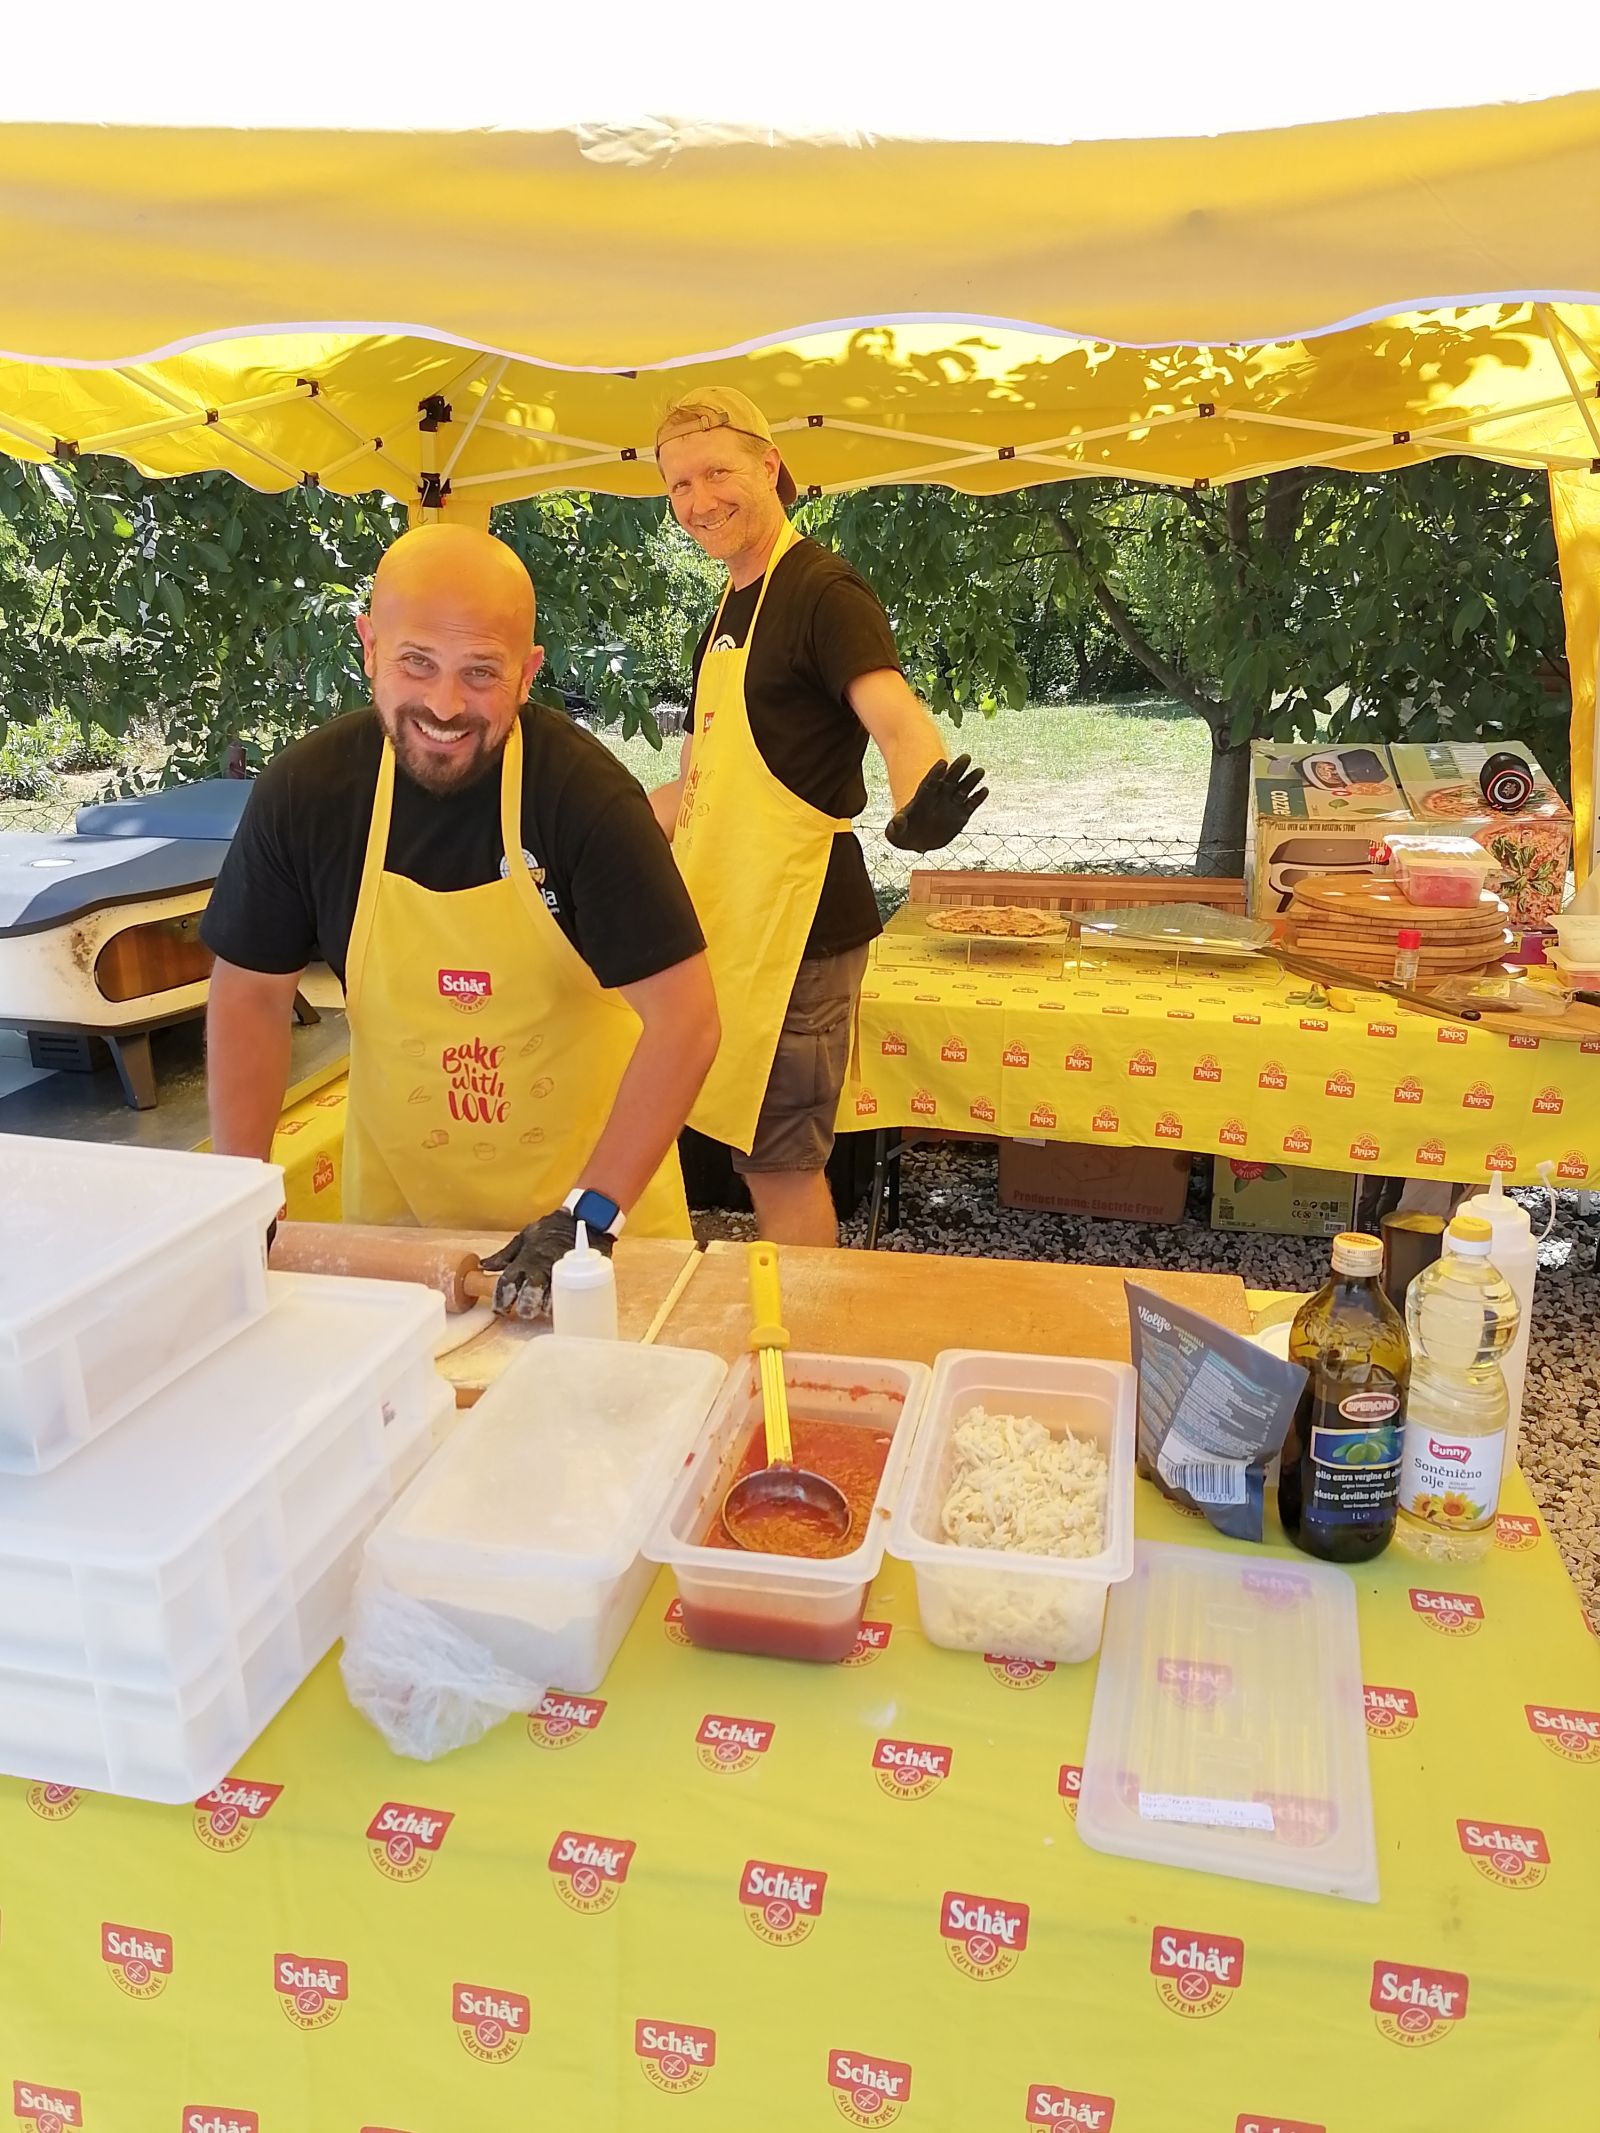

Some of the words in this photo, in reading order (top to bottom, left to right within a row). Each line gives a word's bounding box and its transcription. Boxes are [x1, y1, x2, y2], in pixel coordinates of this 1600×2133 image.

[1309, 824, 1320, 832] WITH
[1343, 824, 1356, 832] STONE
[442, 974, 487, 996] Schär
[442, 1037, 506, 1074] Bake
[452, 1063, 504, 1098] with
[1014, 1190, 1056, 1204] Product
[1091, 1200, 1133, 1213] Electric
[1135, 1203, 1164, 1216] Fryer
[1137, 1305, 1172, 1333] Violife
[1345, 1400, 1394, 1412] SPERONI
[1432, 1443, 1467, 1459] Sunny
[1315, 1470, 1331, 1480] olio
[1355, 1472, 1382, 1482] vergine
[1383, 1470, 1391, 1479] di
[1414, 1457, 1482, 1479] Sončnično
[1421, 1475, 1444, 1489] olje
[1314, 1489, 1339, 1500] ekstra
[1415, 1592, 1476, 1616] Schär
[538, 1698, 597, 1726] Schär
[1363, 1691, 1409, 1714] chär
[704, 1720, 766, 1748] Schär
[1533, 1710, 1600, 1737] Schär
[880, 1745, 944, 1775] Schär
[32, 1786, 82, 1817] GLUTEN-FREE
[208, 1782, 270, 1815] Schär
[198, 1816, 249, 1849] GLUTEN-FREE
[377, 1809, 443, 1843] Schär
[1465, 1825, 1539, 1859] Schär
[557, 1837, 626, 1876] Schär
[747, 1866, 818, 1910] Schär
[948, 1899, 1021, 1945] Schär
[107, 1931, 166, 1968] Schär
[1159, 1935, 1235, 1981] Schär
[280, 1961, 341, 1995] Schär
[1380, 1972, 1459, 2016] Schär
[459, 1991, 523, 2028] Schär
[641, 2027, 708, 2062] Schär
[835, 2057, 904, 2097] Schär
[20, 2088, 75, 2121] Schär
[1034, 2092, 1106, 2130] Schär
